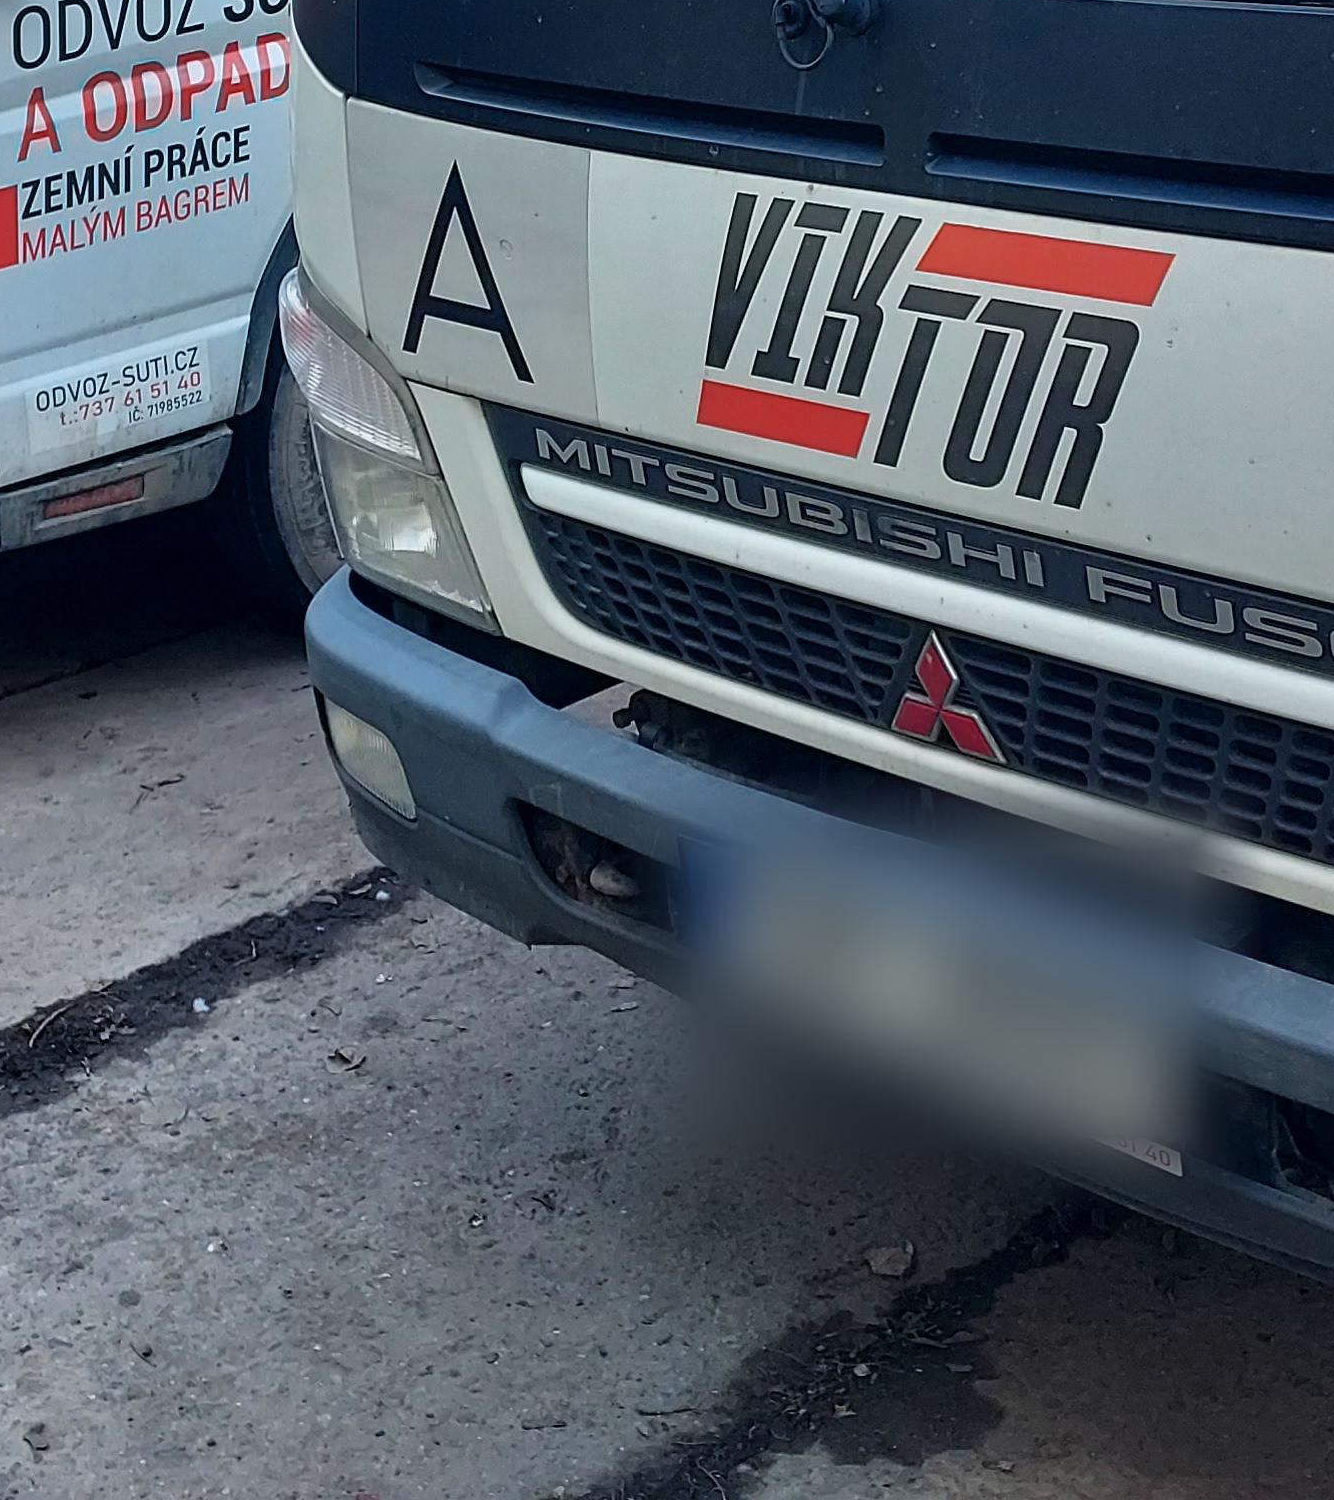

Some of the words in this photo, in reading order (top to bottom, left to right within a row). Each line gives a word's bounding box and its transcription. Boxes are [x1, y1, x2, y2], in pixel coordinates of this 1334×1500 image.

[16, 86, 63, 163] A
[82, 31, 291, 144] ODPAD
[21, 134, 133, 221] ZEMNÍ
[144, 124, 252, 189] PRÁCE
[21, 206, 127, 265] MALÝM
[136, 173, 251, 233] BAGREM
[401, 158, 535, 384] A
[36, 346, 201, 412] ODVOZ-SUTI.CZ
[123, 387, 143, 408] 61
[150, 380, 169, 400] 51
[177, 370, 202, 391] 40
[703, 190, 1142, 511] VIKTOR
[147, 389, 203, 418] 71985522
[533, 424, 1046, 590] MITSUBISHI
